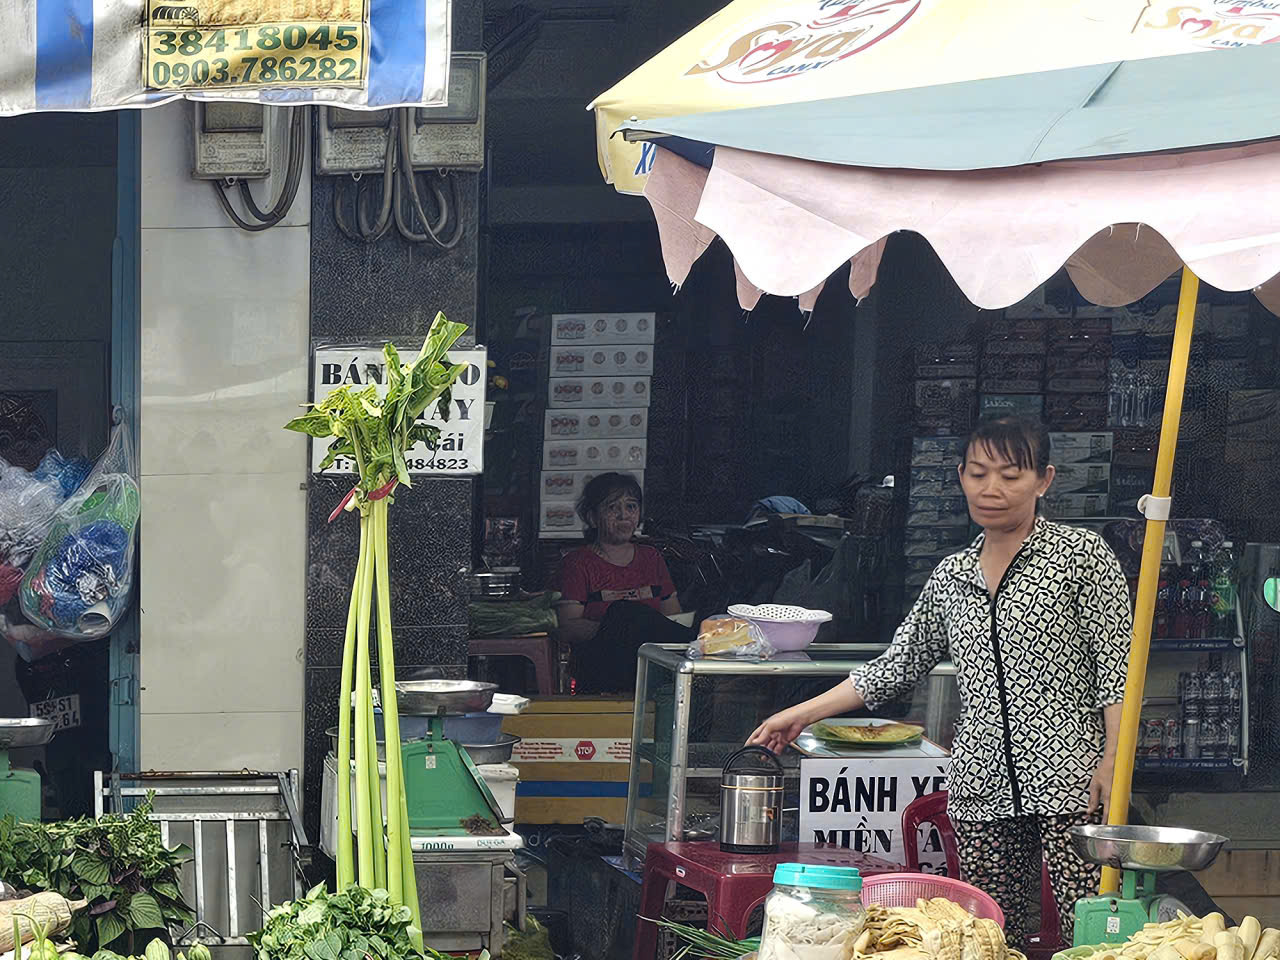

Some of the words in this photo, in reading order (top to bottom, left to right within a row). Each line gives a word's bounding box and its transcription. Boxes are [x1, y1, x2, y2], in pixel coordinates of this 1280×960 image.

[153, 25, 358, 55] 38418045
[152, 57, 357, 86] 0903.786282
[578, 746, 593, 755] STOP
[809, 767, 898, 812] BÁNH
